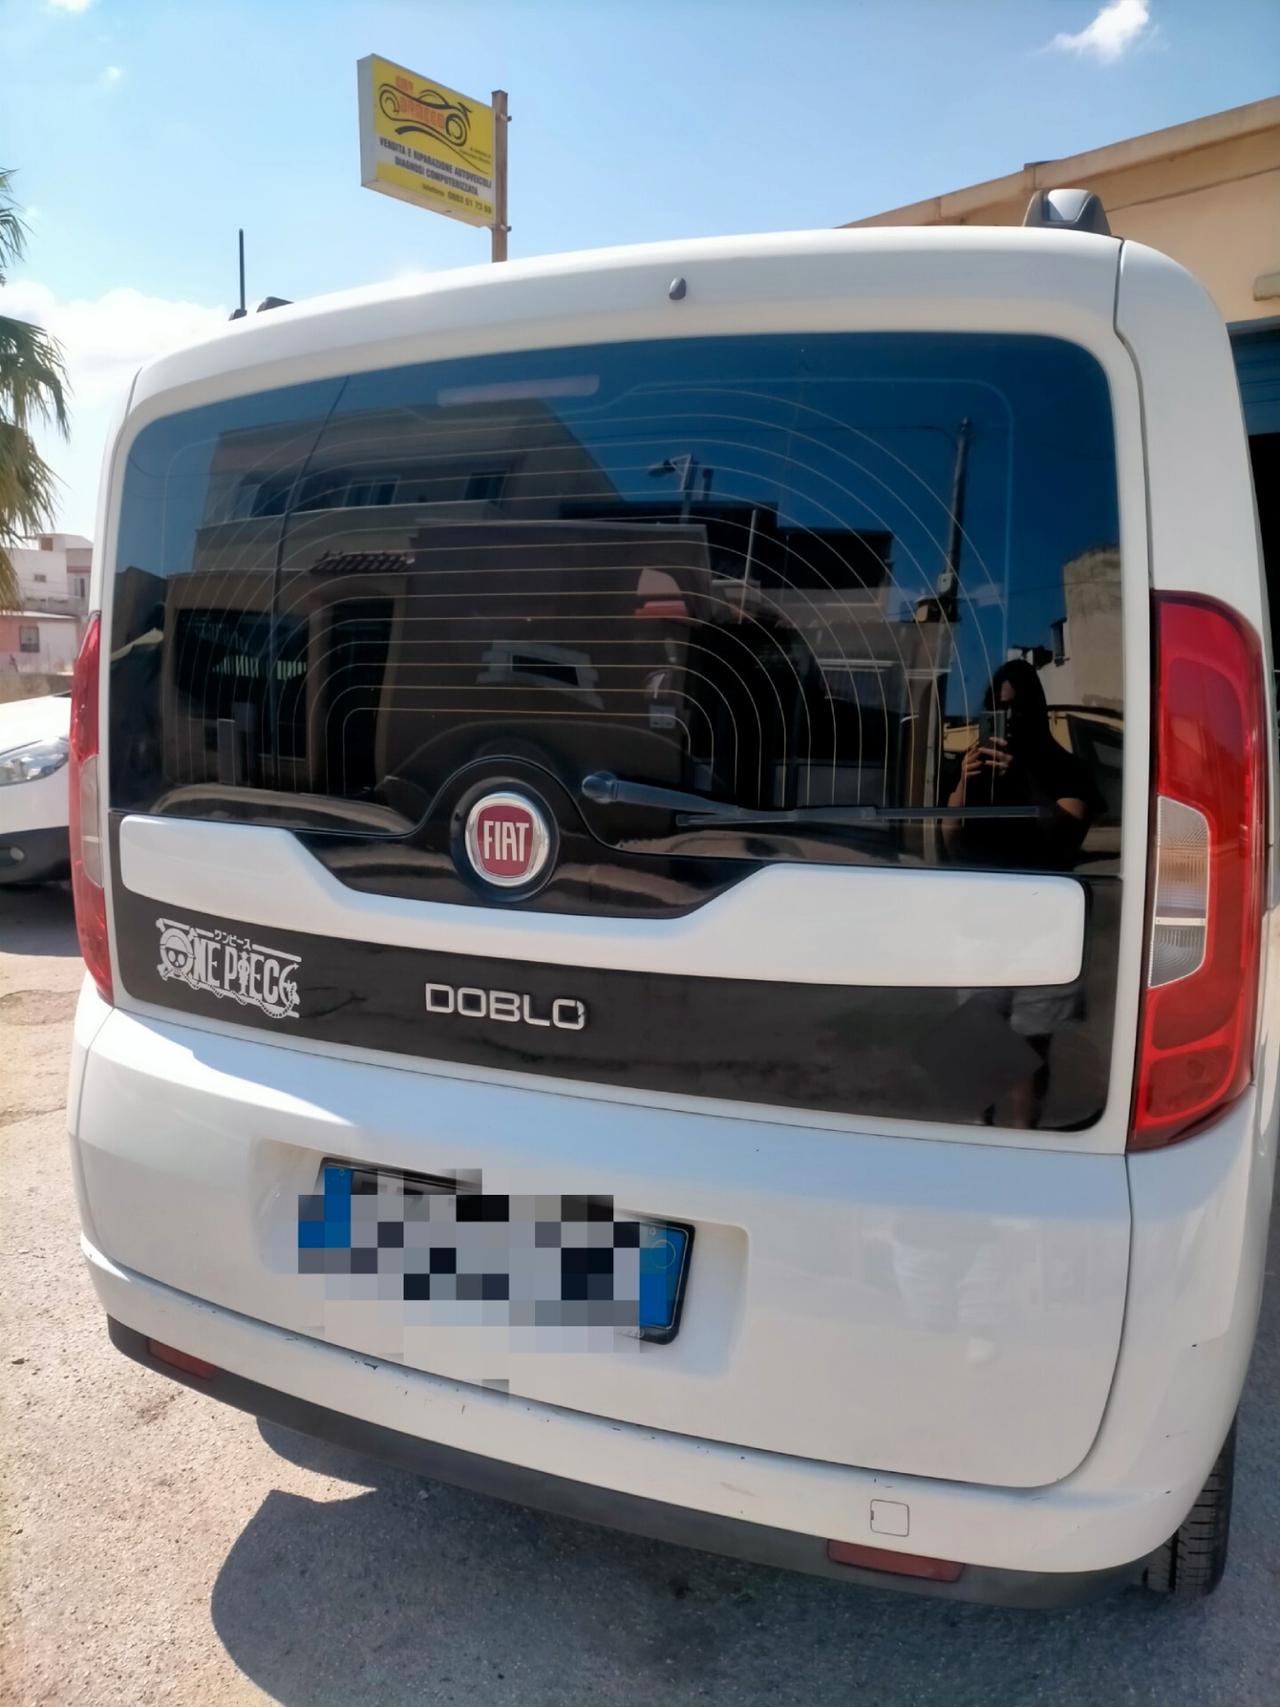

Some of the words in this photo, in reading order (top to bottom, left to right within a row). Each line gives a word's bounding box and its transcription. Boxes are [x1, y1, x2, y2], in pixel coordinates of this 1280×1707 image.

[379, 136, 406, 155] VENDITA
[407, 146, 412, 158] E
[413, 149, 453, 174] RIPARAZIONE
[454, 167, 492, 189] AUTOVEICOLI
[395, 155, 425, 176] DIAGNOSI
[426, 167, 479, 196] COMPUTERIZZATA
[483, 820, 530, 863] FIAT
[425, 982, 586, 1031] DOBLO
